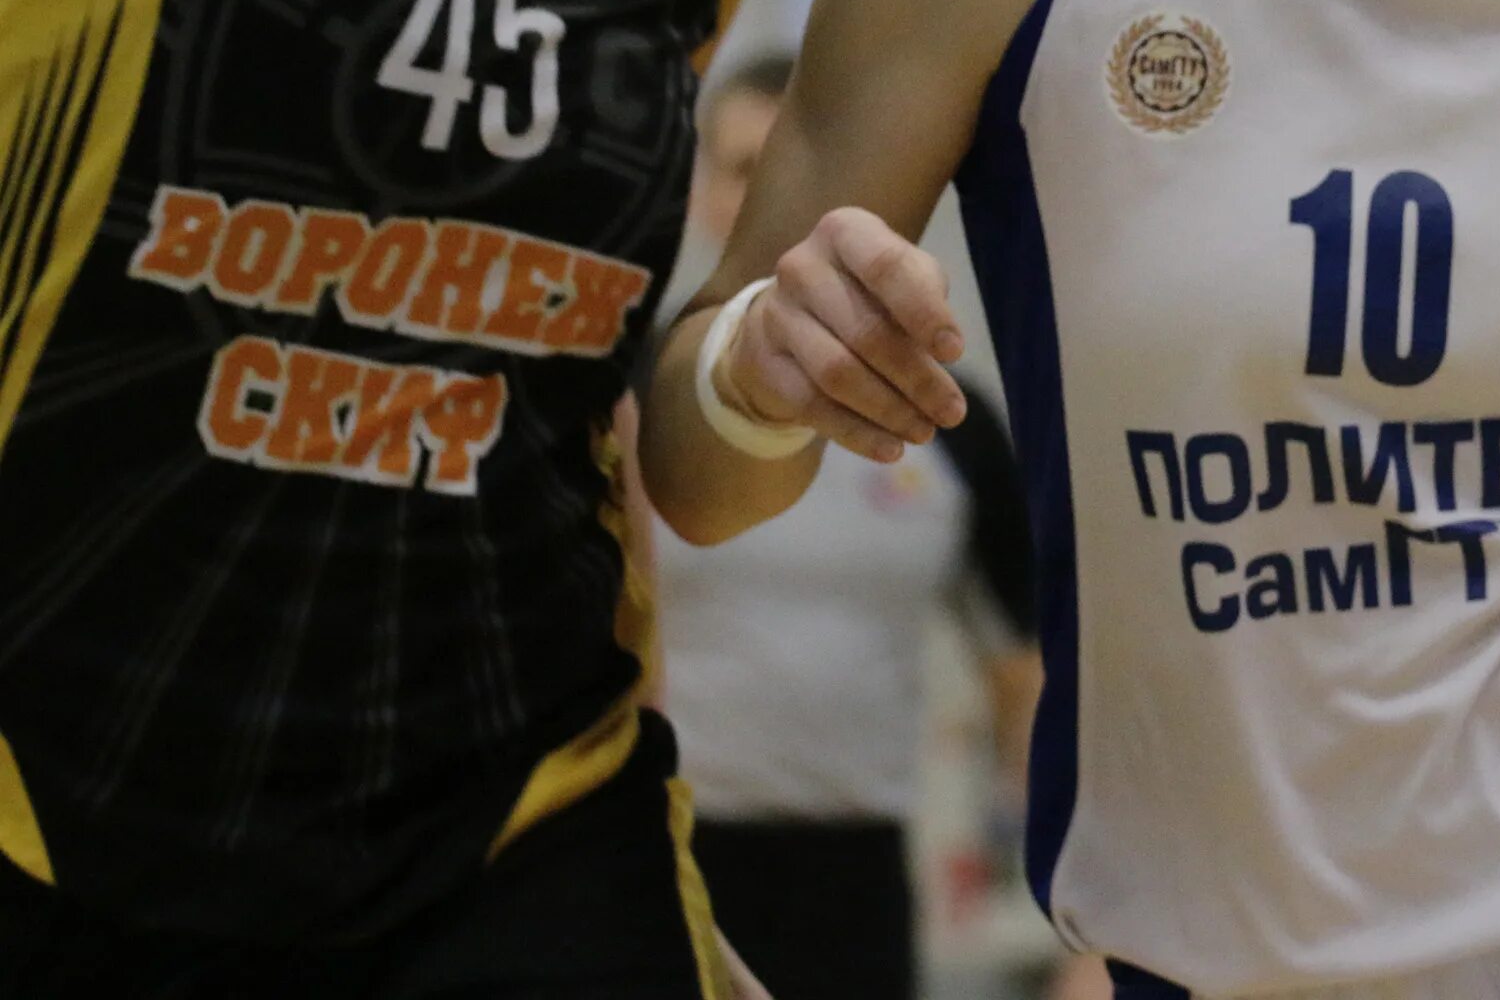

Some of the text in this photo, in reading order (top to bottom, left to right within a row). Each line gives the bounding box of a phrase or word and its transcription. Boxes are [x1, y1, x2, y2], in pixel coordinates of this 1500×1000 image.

[127, 184, 652, 358] ВОРОНЕЖ
[1288, 168, 1455, 388] 10
[196, 335, 508, 497] СКИФ
